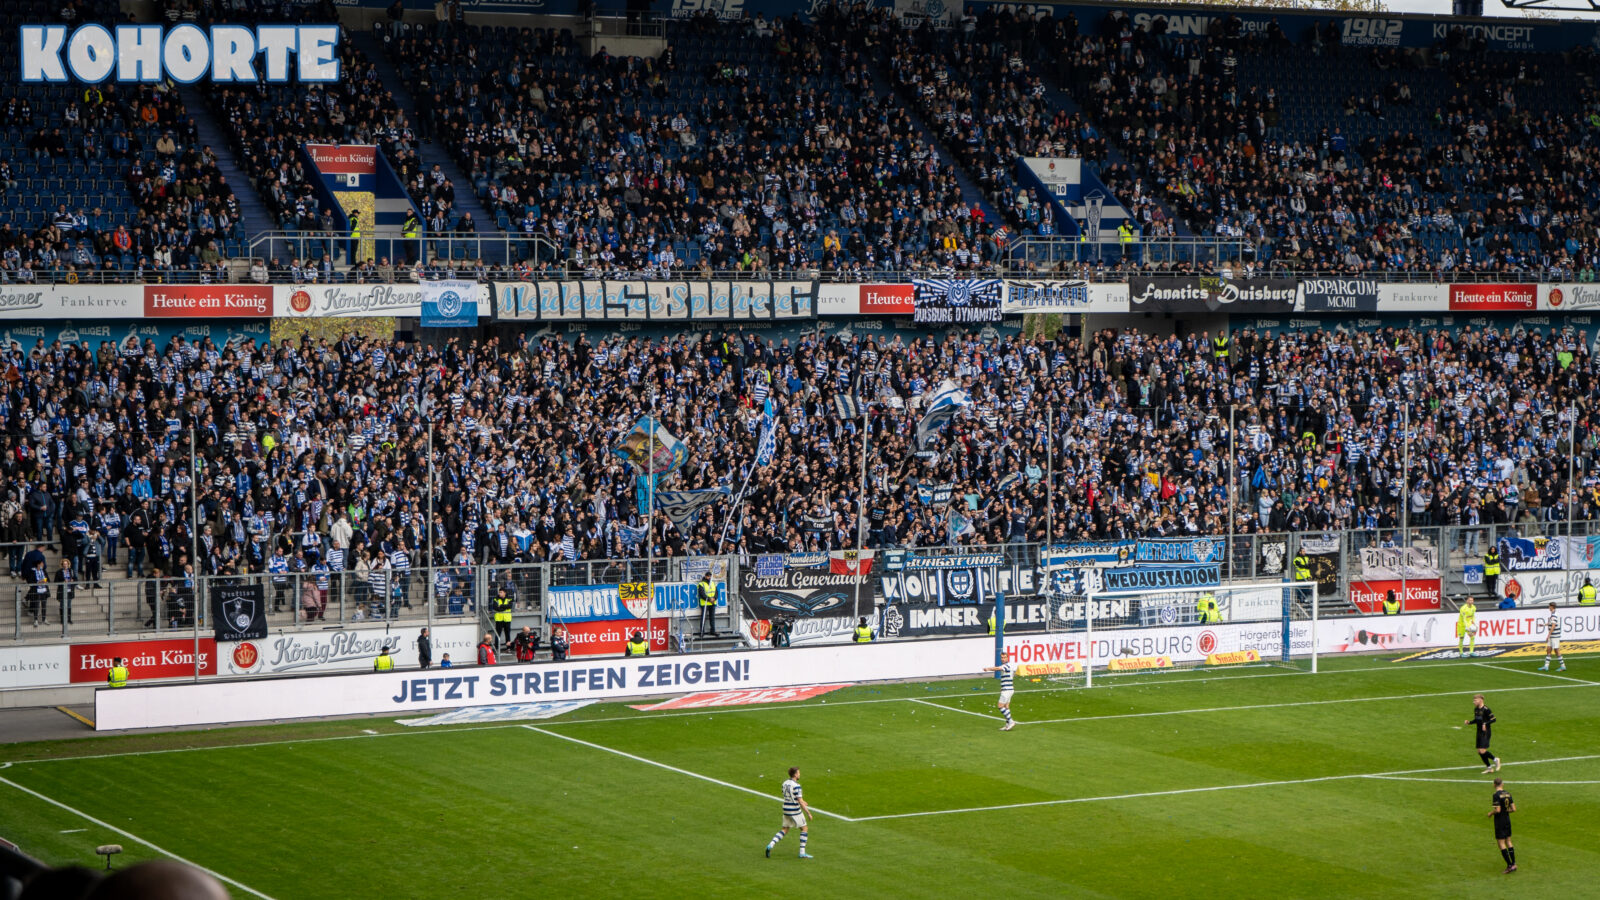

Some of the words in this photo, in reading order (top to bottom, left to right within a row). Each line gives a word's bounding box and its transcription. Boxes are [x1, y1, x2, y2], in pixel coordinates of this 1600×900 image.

[1343, 18, 1403, 38] 1902
[334, 153, 348, 163] ein
[350, 153, 374, 166] König
[351, 175, 356, 185] 9
[1056, 185, 1066, 194] 10
[1133, 283, 1209, 304] Fanatics
[1217, 283, 1297, 304] Duisburg
[1304, 279, 1377, 295] DISPARGUM
[61, 296, 127, 307] Fankurve
[153, 294, 195, 309] Heute
[199, 295, 220, 308] ein
[224, 294, 267, 312] König
[321, 288, 371, 312] König
[866, 292, 902, 305] Heute
[904, 293, 915, 304] ei
[1327, 296, 1356, 308] MCMII
[1393, 292, 1438, 302] Fankurve
[1455, 291, 1485, 303] Heute
[1487, 293, 1501, 303] ein
[1503, 291, 1532, 306] König
[914, 307, 953, 323] DUISBURG
[956, 306, 1002, 322] DYNAMITES
[1213, 540, 1226, 561] 47
[1366, 550, 1415, 568] Block
[745, 572, 789, 588] Proud
[1106, 567, 1219, 588] WEDAUSTADION
[548, 588, 619, 617] RUHRPOTT
[656, 582, 727, 612] DUISBG
[1238, 595, 1284, 608] Fankurv
[1350, 590, 1385, 603] Heute
[1392, 589, 1404, 601] in
[1406, 587, 1439, 604] König
[910, 606, 982, 629] IMMER
[1058, 600, 1130, 621] GEBEN!
[603, 628, 620, 641] ein
[1289, 627, 1308, 638] aller
[270, 636, 333, 664] König
[329, 631, 401, 657] Pilsener
[411, 639, 471, 651] Fkurve
[81, 654, 129, 670] Heue
[132, 653, 156, 667] ein
[1117, 658, 1151, 670] Sinalco
[1214, 652, 1244, 664] Sinalco
[1026, 663, 1061, 676] Sinalco
[392, 675, 480, 703] JETZT
[489, 667, 627, 697] STREIFEN
[637, 659, 751, 688] ZEIGEN!
